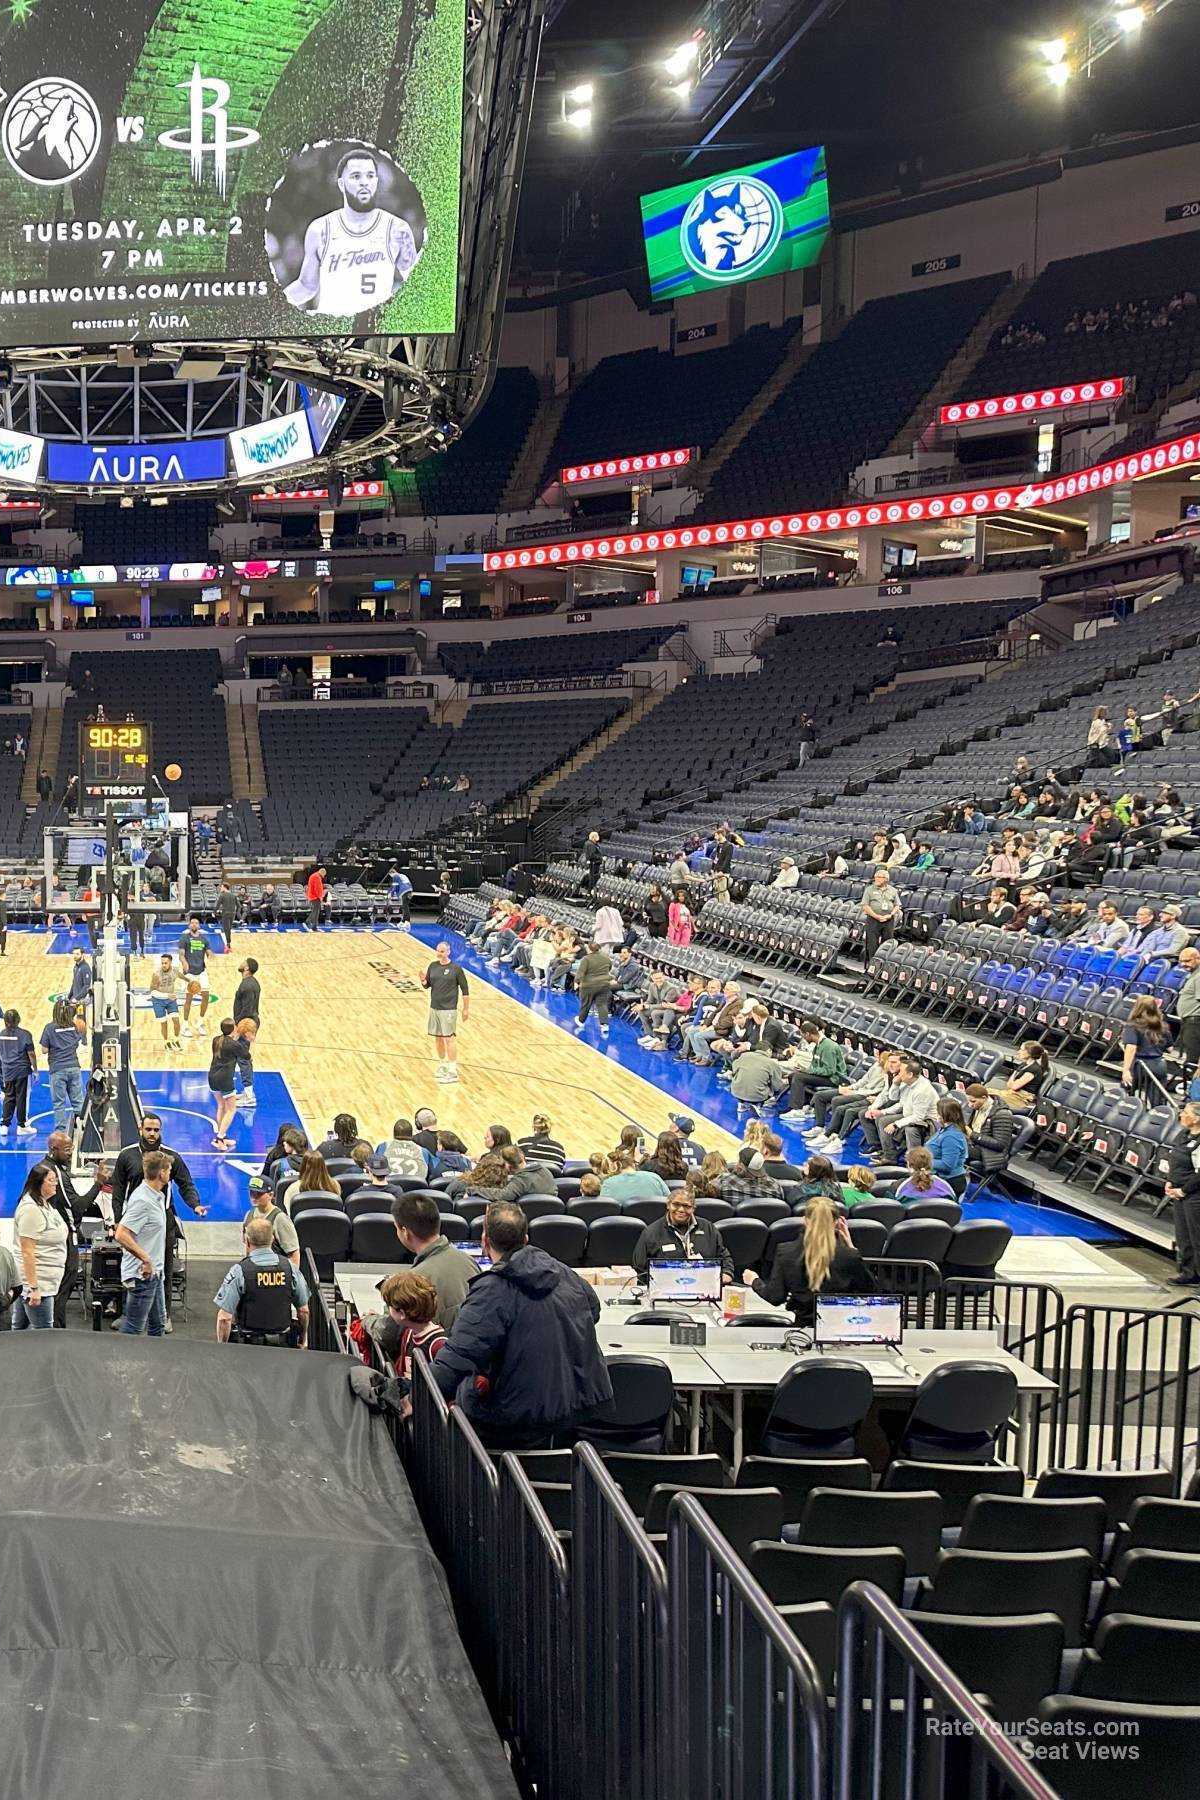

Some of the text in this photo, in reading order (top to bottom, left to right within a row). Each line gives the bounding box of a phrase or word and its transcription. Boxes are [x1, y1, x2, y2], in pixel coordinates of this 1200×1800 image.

[116, 116, 145, 143] VS
[22, 217, 243, 243] TUESDAY, APR. 2
[101, 249, 164, 269] 7 PM
[328, 249, 386, 273] H-Town
[925, 261, 947, 274] 205
[361, 274, 377, 295] 5
[72, 319, 125, 329] PROTECTED
[127, 319, 140, 328] BY
[688, 330, 706, 341] 204
[98, 570, 105, 581] 0
[126, 566, 160, 579] 90:28
[182, 568, 189, 578] 0
[886, 586, 903, 595] 106
[573, 615, 586, 623] 104
[132, 632, 144, 640] 101
[89, 729, 142, 748] 90:28
[102, 786, 145, 795] TISSOT
[389, 1157, 418, 1175] 32
[257, 1272, 286, 1286] POLICE
